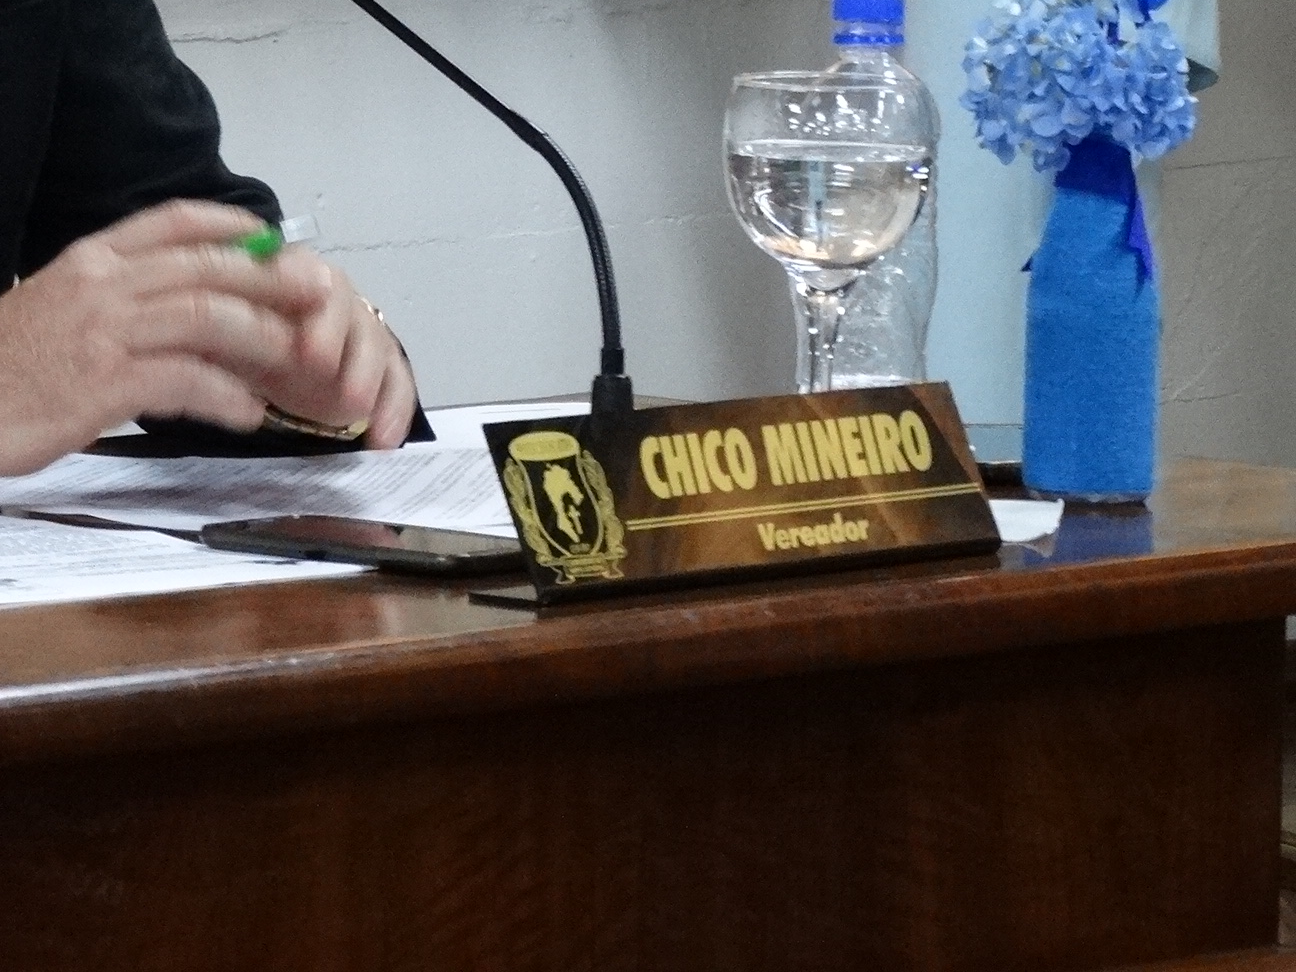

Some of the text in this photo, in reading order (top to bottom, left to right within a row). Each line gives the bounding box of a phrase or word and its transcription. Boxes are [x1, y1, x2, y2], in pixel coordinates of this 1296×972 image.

[639, 409, 933, 500] CHICO MINEIRO
[756, 512, 870, 552] Vereador
